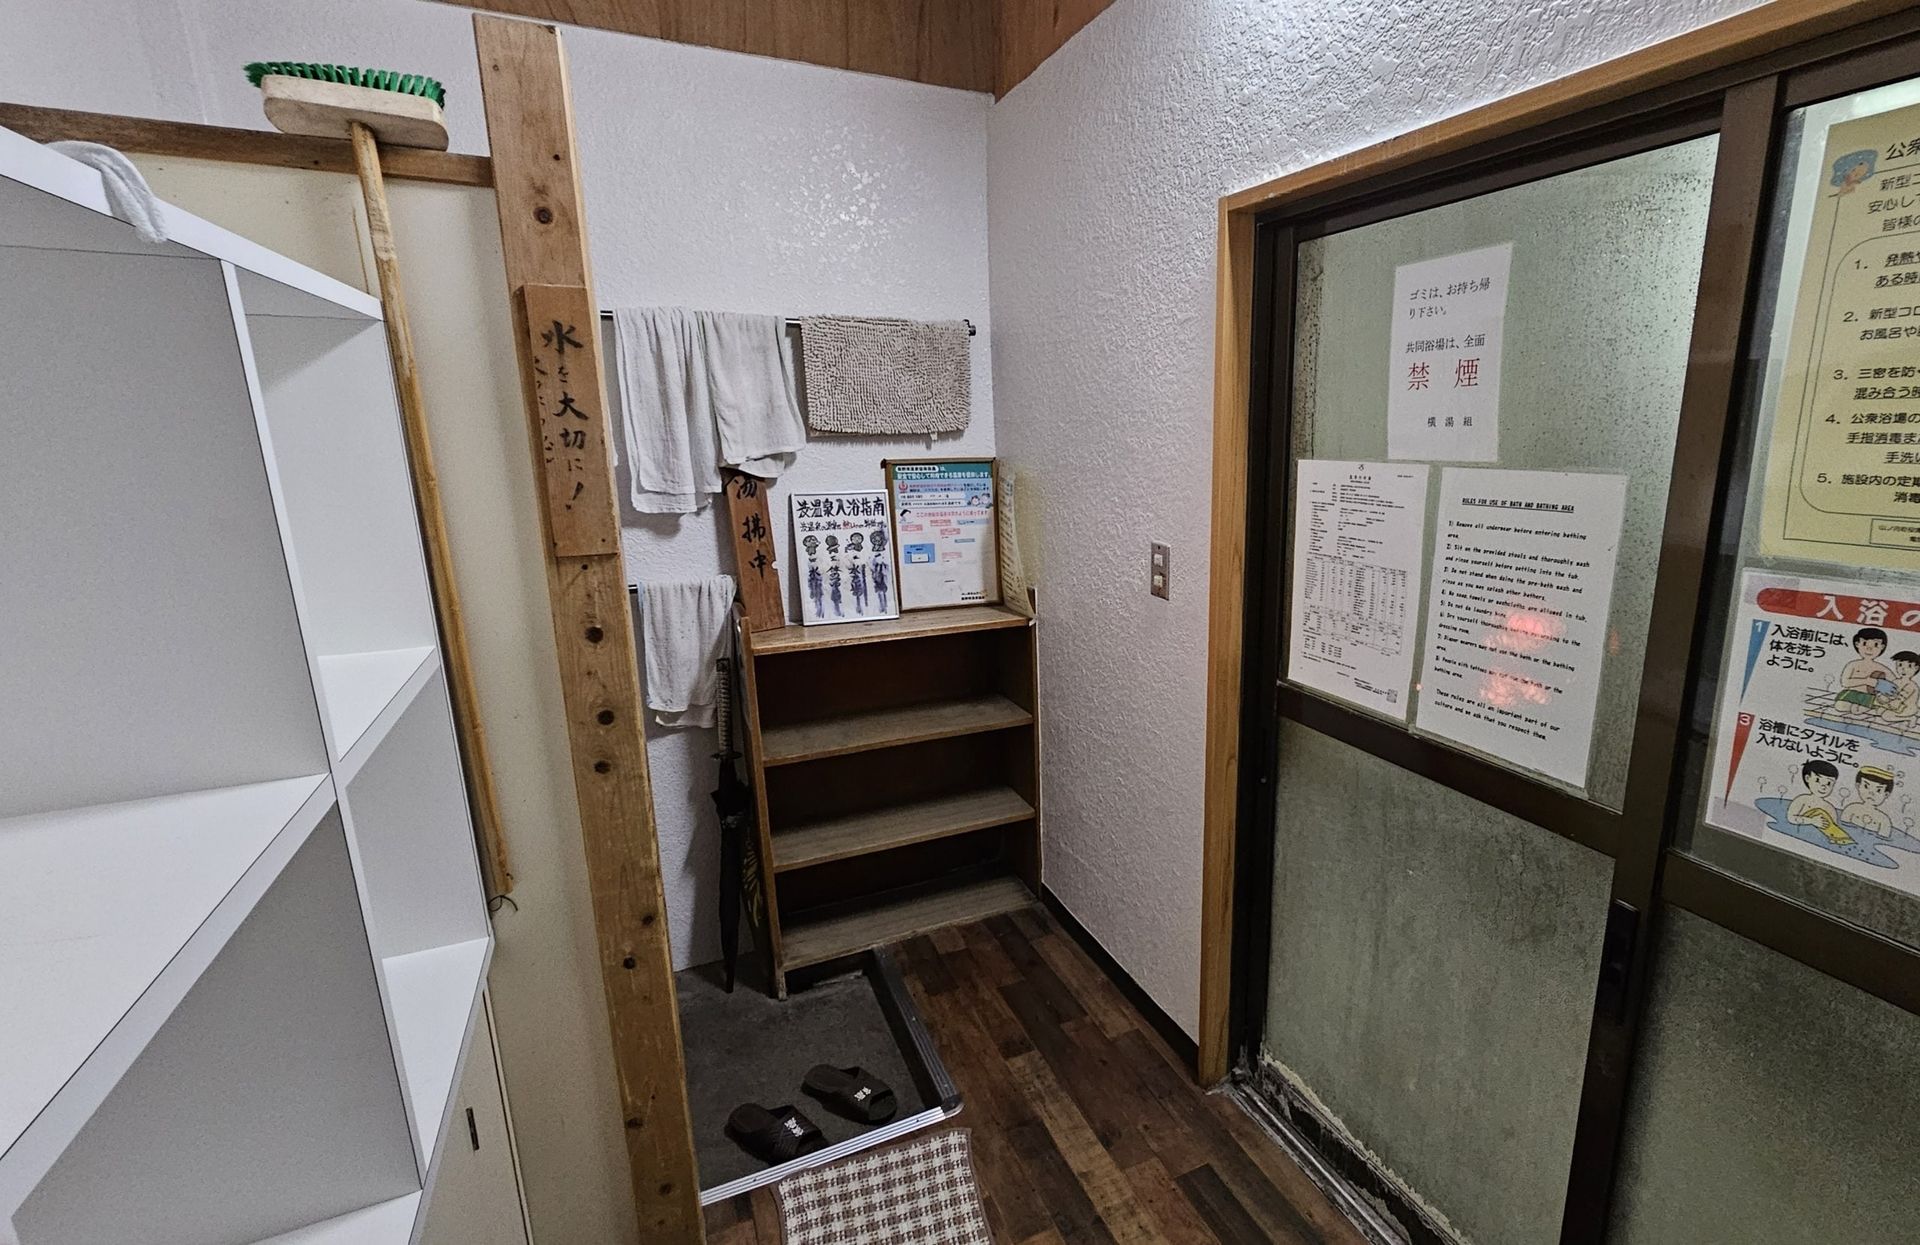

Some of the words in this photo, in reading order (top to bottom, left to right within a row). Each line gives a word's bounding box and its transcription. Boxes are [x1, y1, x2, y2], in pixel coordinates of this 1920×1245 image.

[1885, 250, 1920, 267] 発熱
[1874, 271, 1920, 288] ある時
[1843, 312, 1858, 322] 2.
[1860, 325, 1920, 340] お風呂や
[1408, 358, 1480, 391] 禁煙
[1834, 369, 1848, 380] 3.
[1858, 366, 1920, 379] 三密を防
[1825, 414, 1840, 424] 4.
[1847, 432, 1920, 444] 手指消毒ま
[1817, 473, 1831, 484] 5.
[1771, 623, 1849, 648] 入浴前には、
[1770, 638, 1826, 659] 体を洗う
[1766, 654, 1814, 673] ように。
[1756, 732, 1860, 769] 入れないように。
